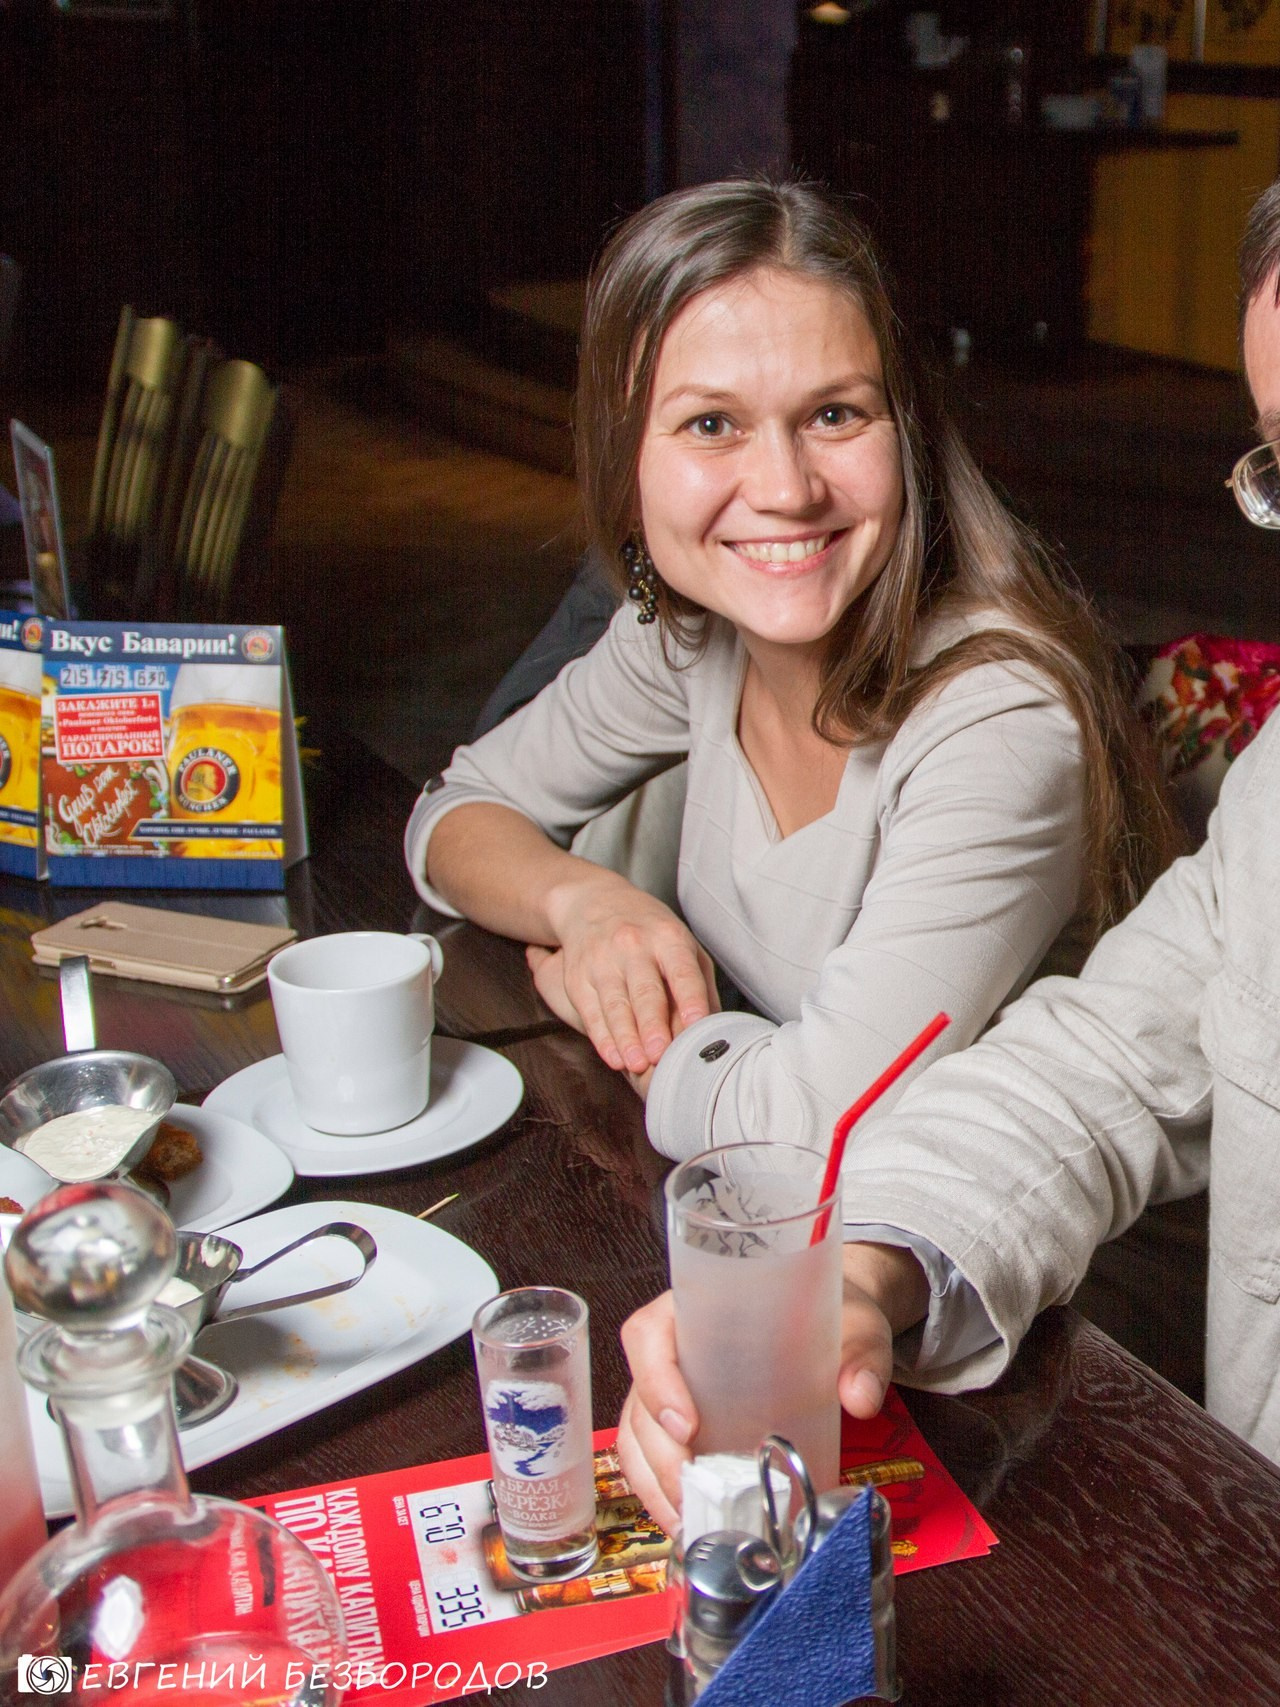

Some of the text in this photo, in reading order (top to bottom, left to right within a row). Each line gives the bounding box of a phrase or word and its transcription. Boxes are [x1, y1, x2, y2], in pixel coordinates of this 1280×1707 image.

[51, 629, 113, 657] Вкус
[122, 631, 238, 659] Баварии!
[57, 697, 137, 712] ЗАКАЖИТЕ
[62, 740, 161, 758] ПОДАРОК!
[507, 1479, 559, 1494] БЕЛАЯ
[274, 1494, 328, 1534] ПО
[419, 1502, 466, 1544] 670
[324, 1487, 371, 1578] КАЖДОМУ
[435, 1584, 485, 1629] 335
